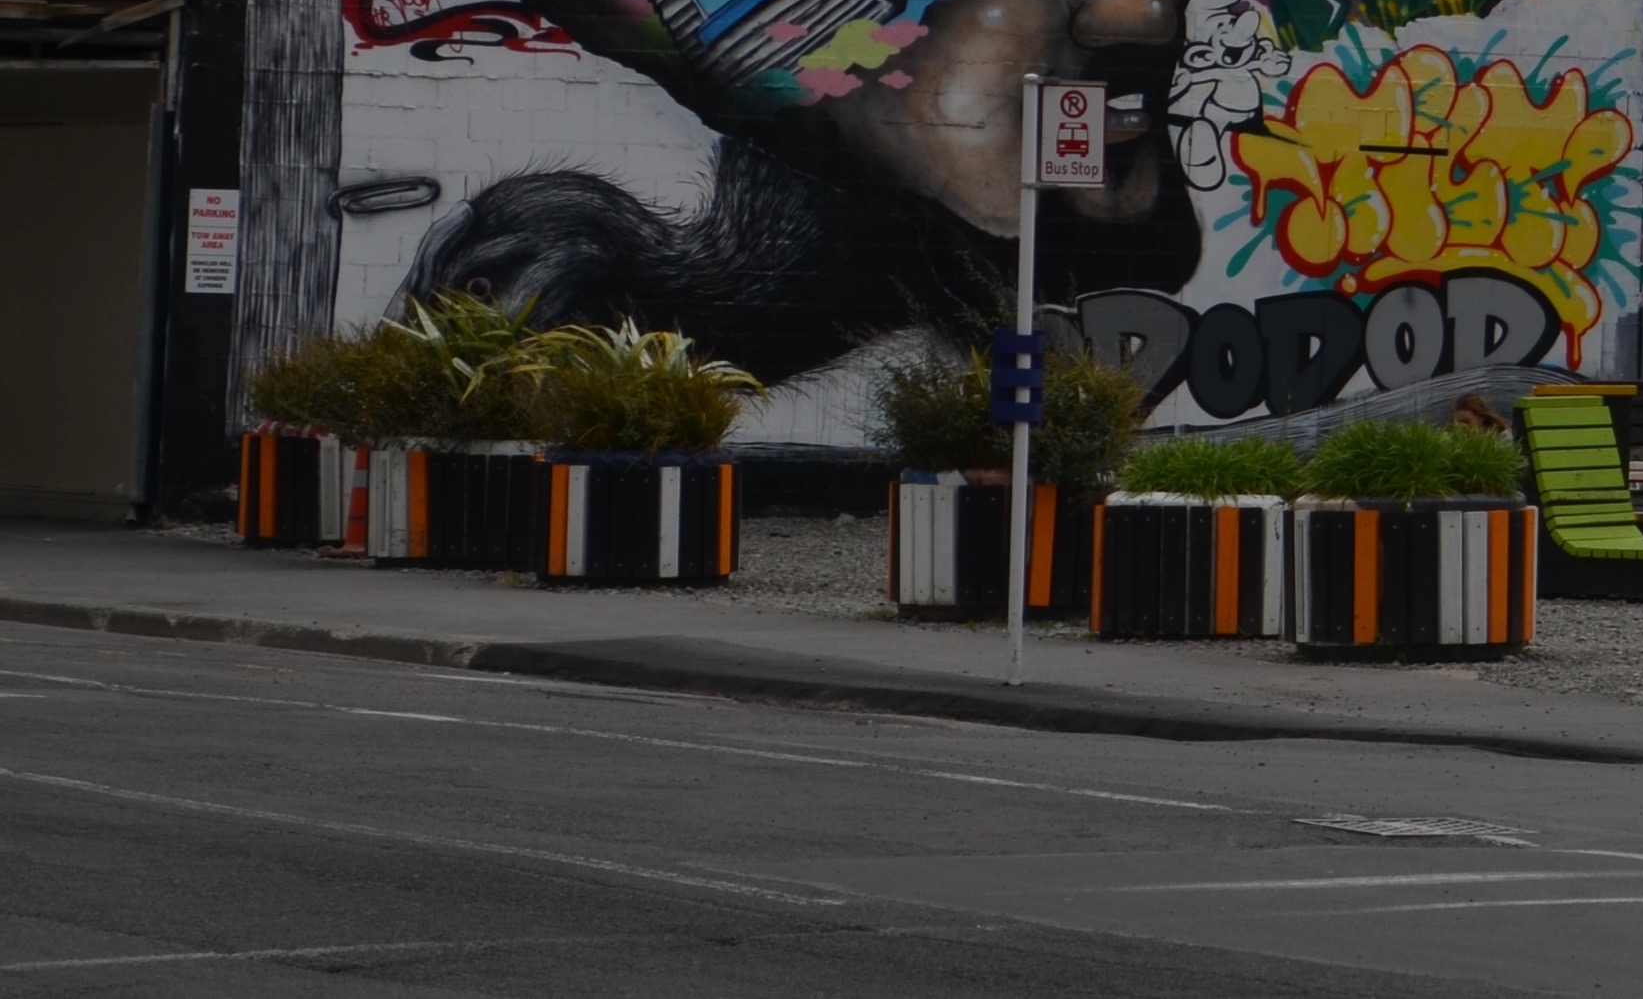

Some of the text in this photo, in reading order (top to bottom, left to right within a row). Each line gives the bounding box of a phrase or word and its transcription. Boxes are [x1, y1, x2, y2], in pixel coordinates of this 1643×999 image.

[1045, 161, 1099, 177] Bus Stop
[206, 196, 221, 205] NO
[193, 208, 236, 219] PARKING
[191, 232, 210, 240] TOW
[201, 241, 224, 250] AREA
